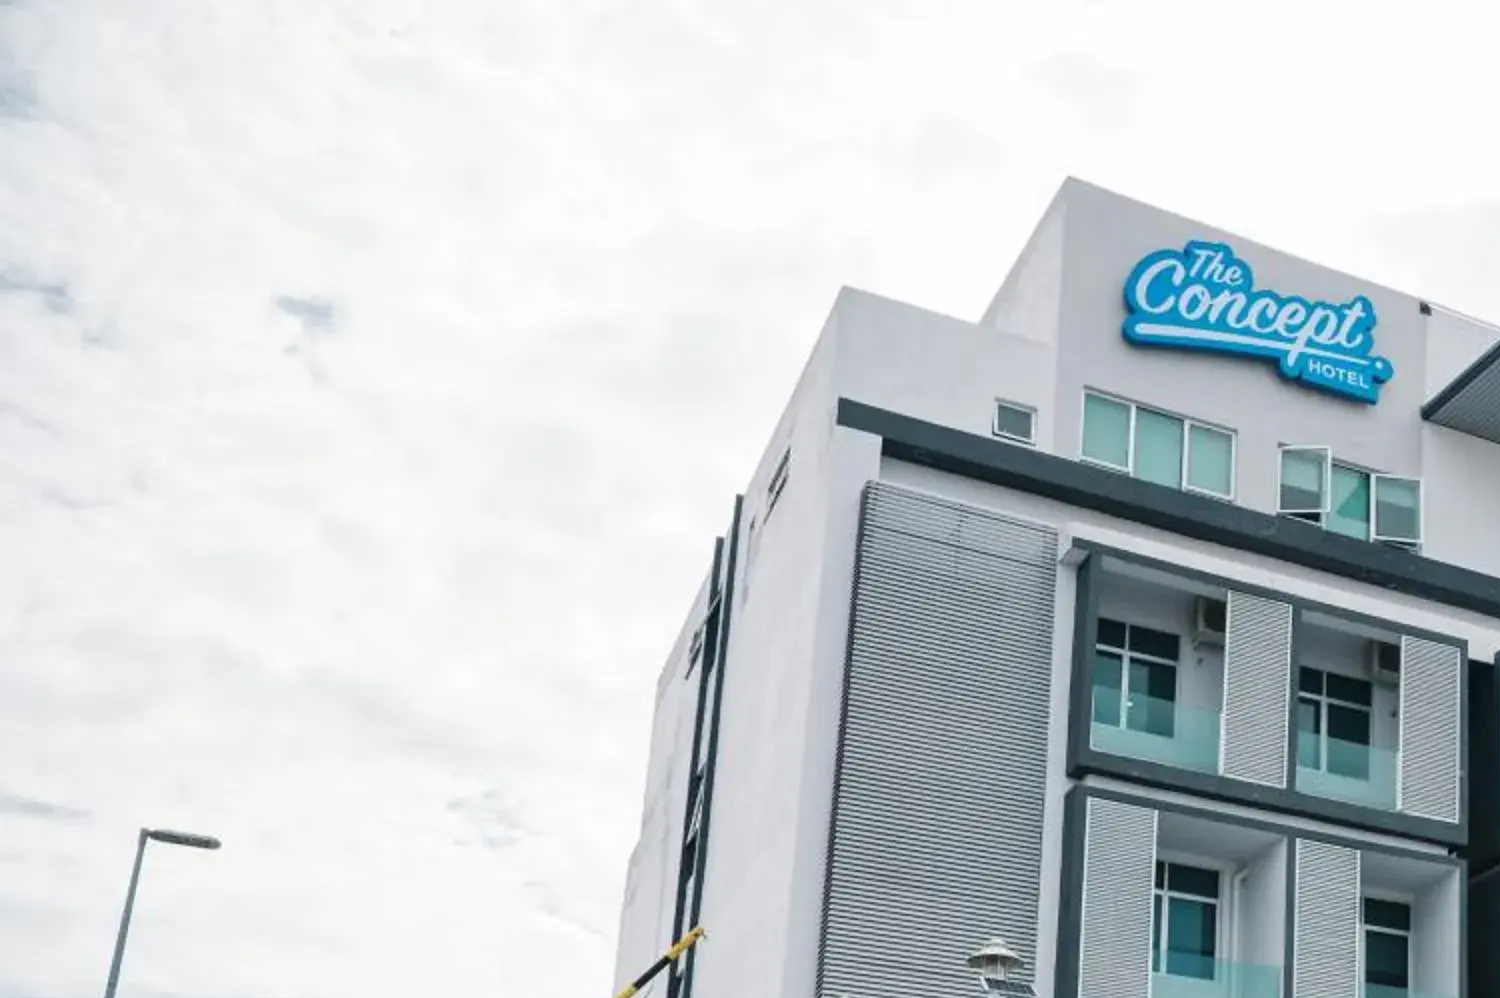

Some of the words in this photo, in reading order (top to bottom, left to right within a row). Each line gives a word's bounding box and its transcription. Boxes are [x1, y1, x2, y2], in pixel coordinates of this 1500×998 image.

[1185, 247, 1244, 286] The
[1135, 258, 1365, 366] Concept
[1308, 357, 1370, 389] HOTEL
